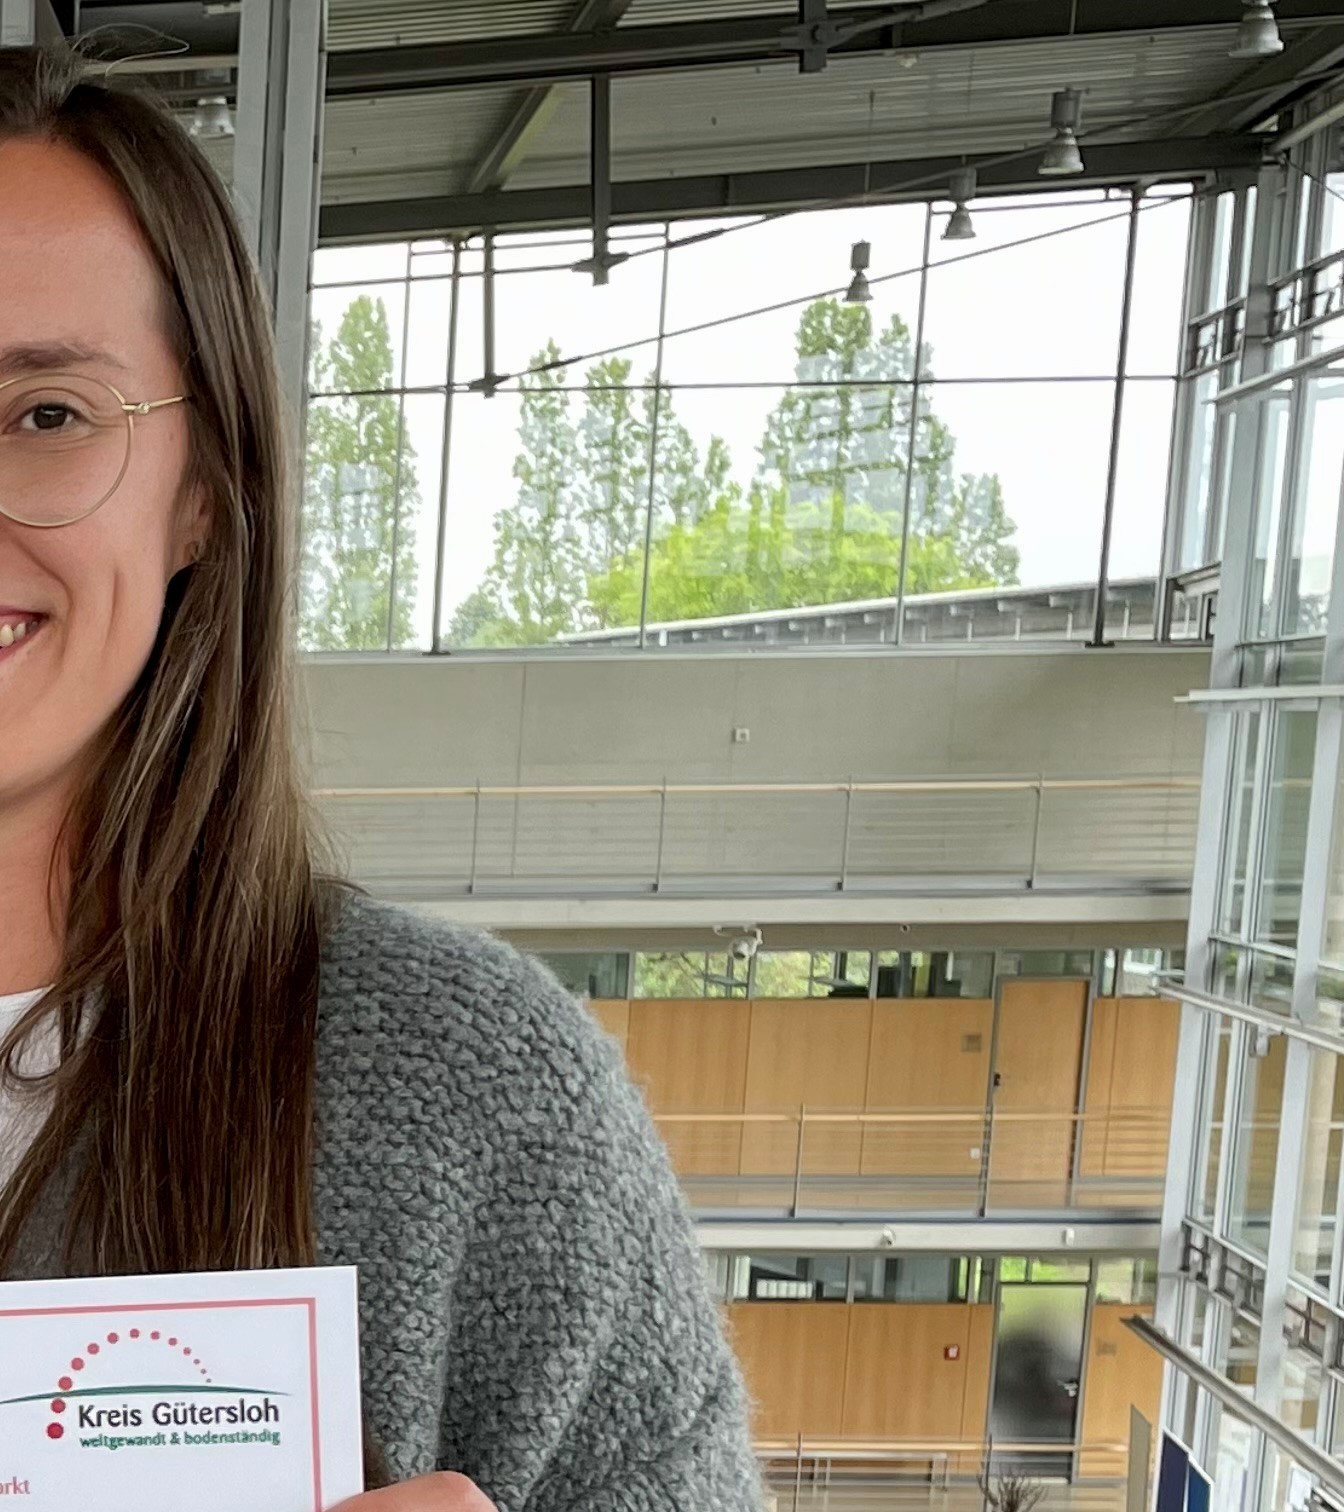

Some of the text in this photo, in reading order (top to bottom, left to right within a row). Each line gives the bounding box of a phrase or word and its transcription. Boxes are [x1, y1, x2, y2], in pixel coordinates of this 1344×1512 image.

[78, 1397, 280, 1429] Kreis Gütersloh
[79, 1428, 281, 1451] weltgewandt & bodenständig
